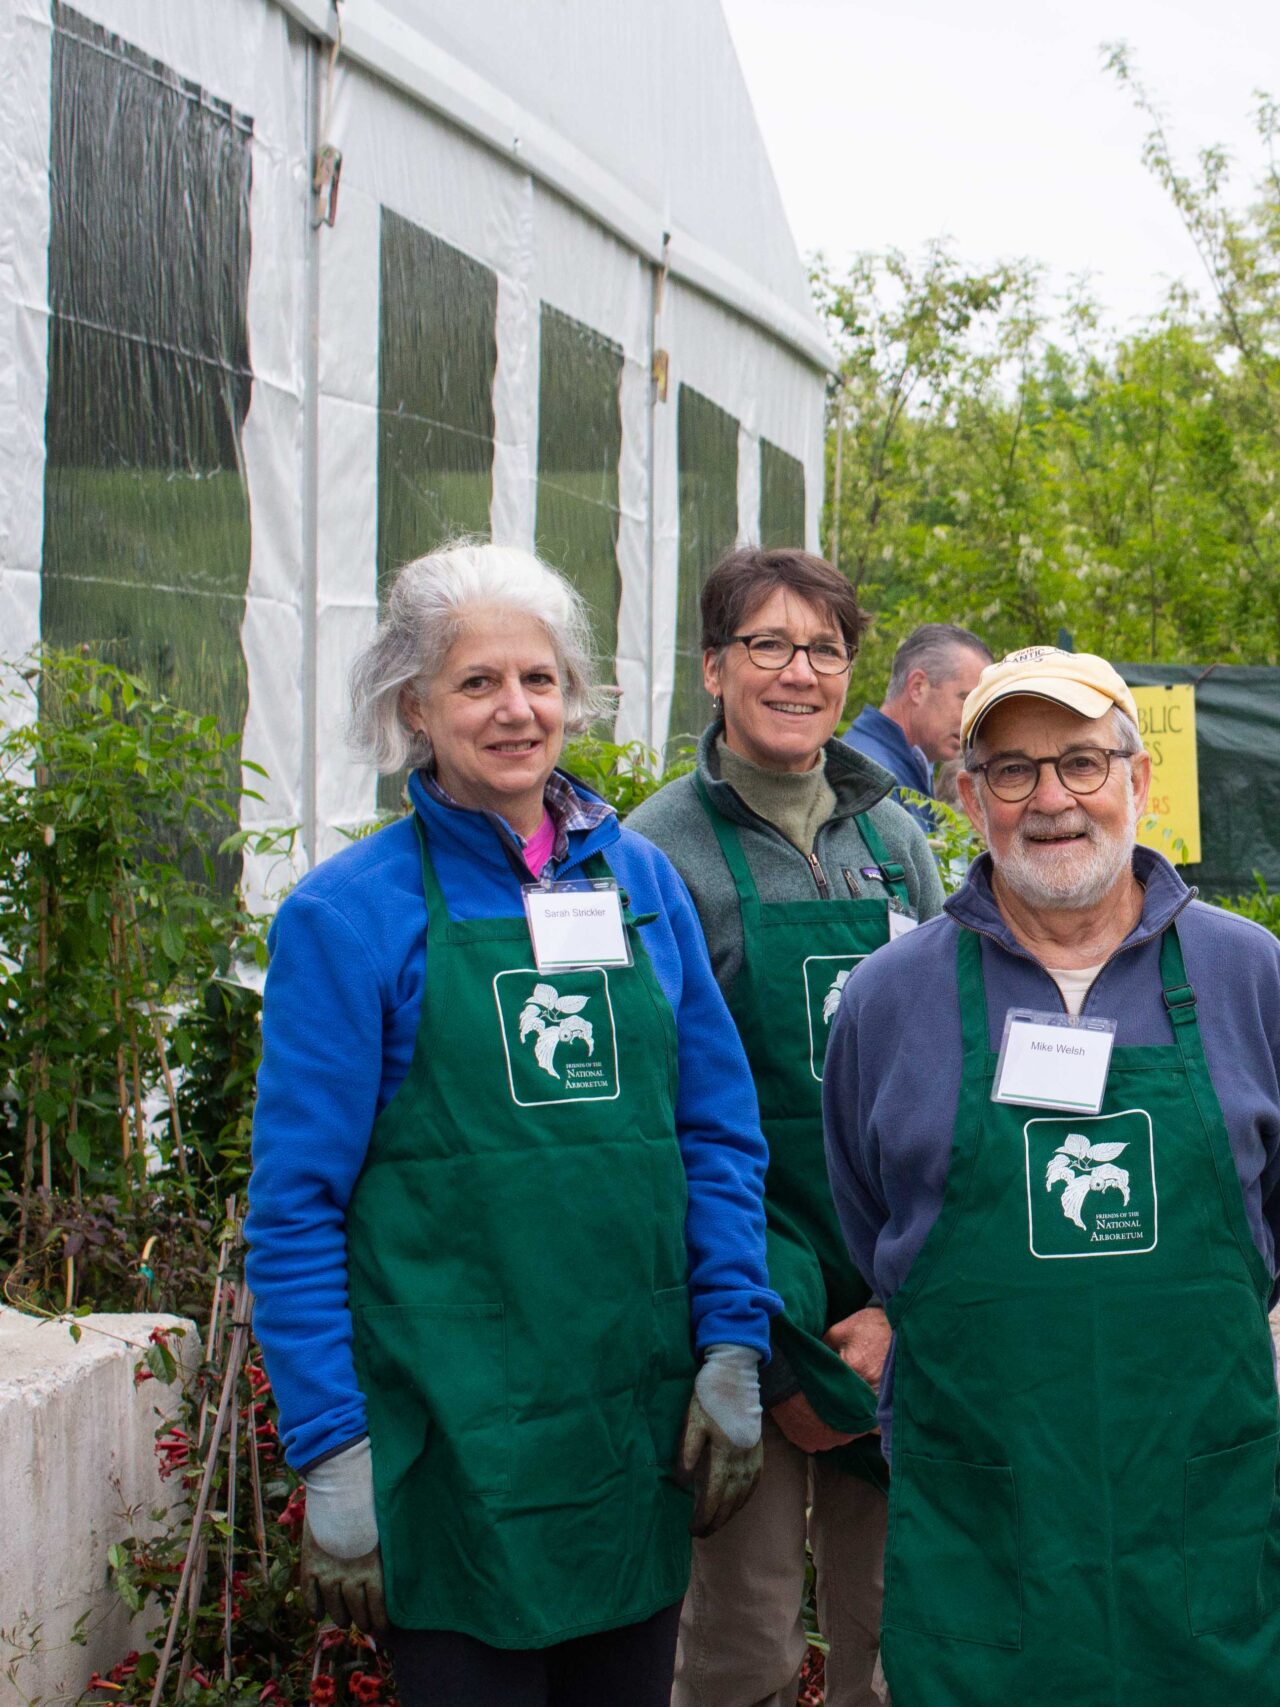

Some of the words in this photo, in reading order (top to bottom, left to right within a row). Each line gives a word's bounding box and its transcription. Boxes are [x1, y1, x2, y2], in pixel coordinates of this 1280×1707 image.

[1137, 704, 1183, 736] BLIC
[544, 908, 570, 918] Sarah
[572, 907, 606, 918] Strickler
[1030, 1041, 1053, 1052] Mike
[1056, 1043, 1086, 1056] Welsh
